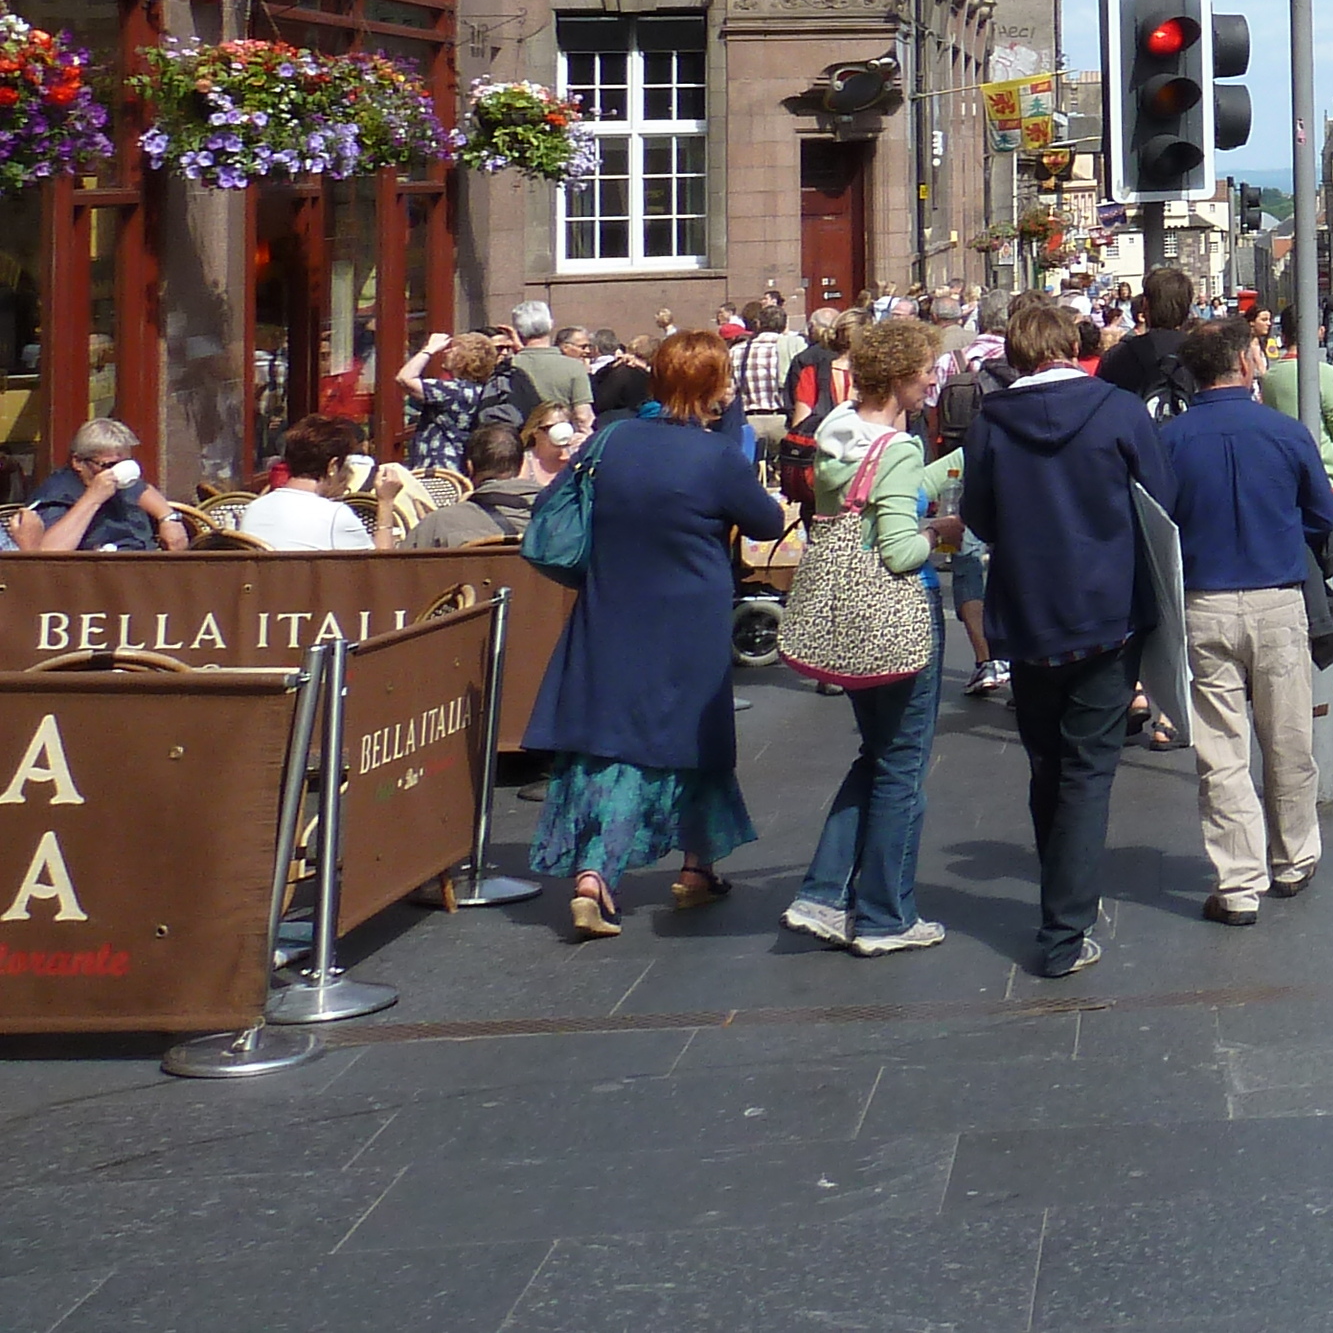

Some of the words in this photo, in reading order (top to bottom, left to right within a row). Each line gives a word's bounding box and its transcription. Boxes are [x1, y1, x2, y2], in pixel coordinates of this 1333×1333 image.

[37, 611, 228, 651] BELLA
[359, 718, 416, 774] BELLA
[420, 693, 471, 747] ITALIA
